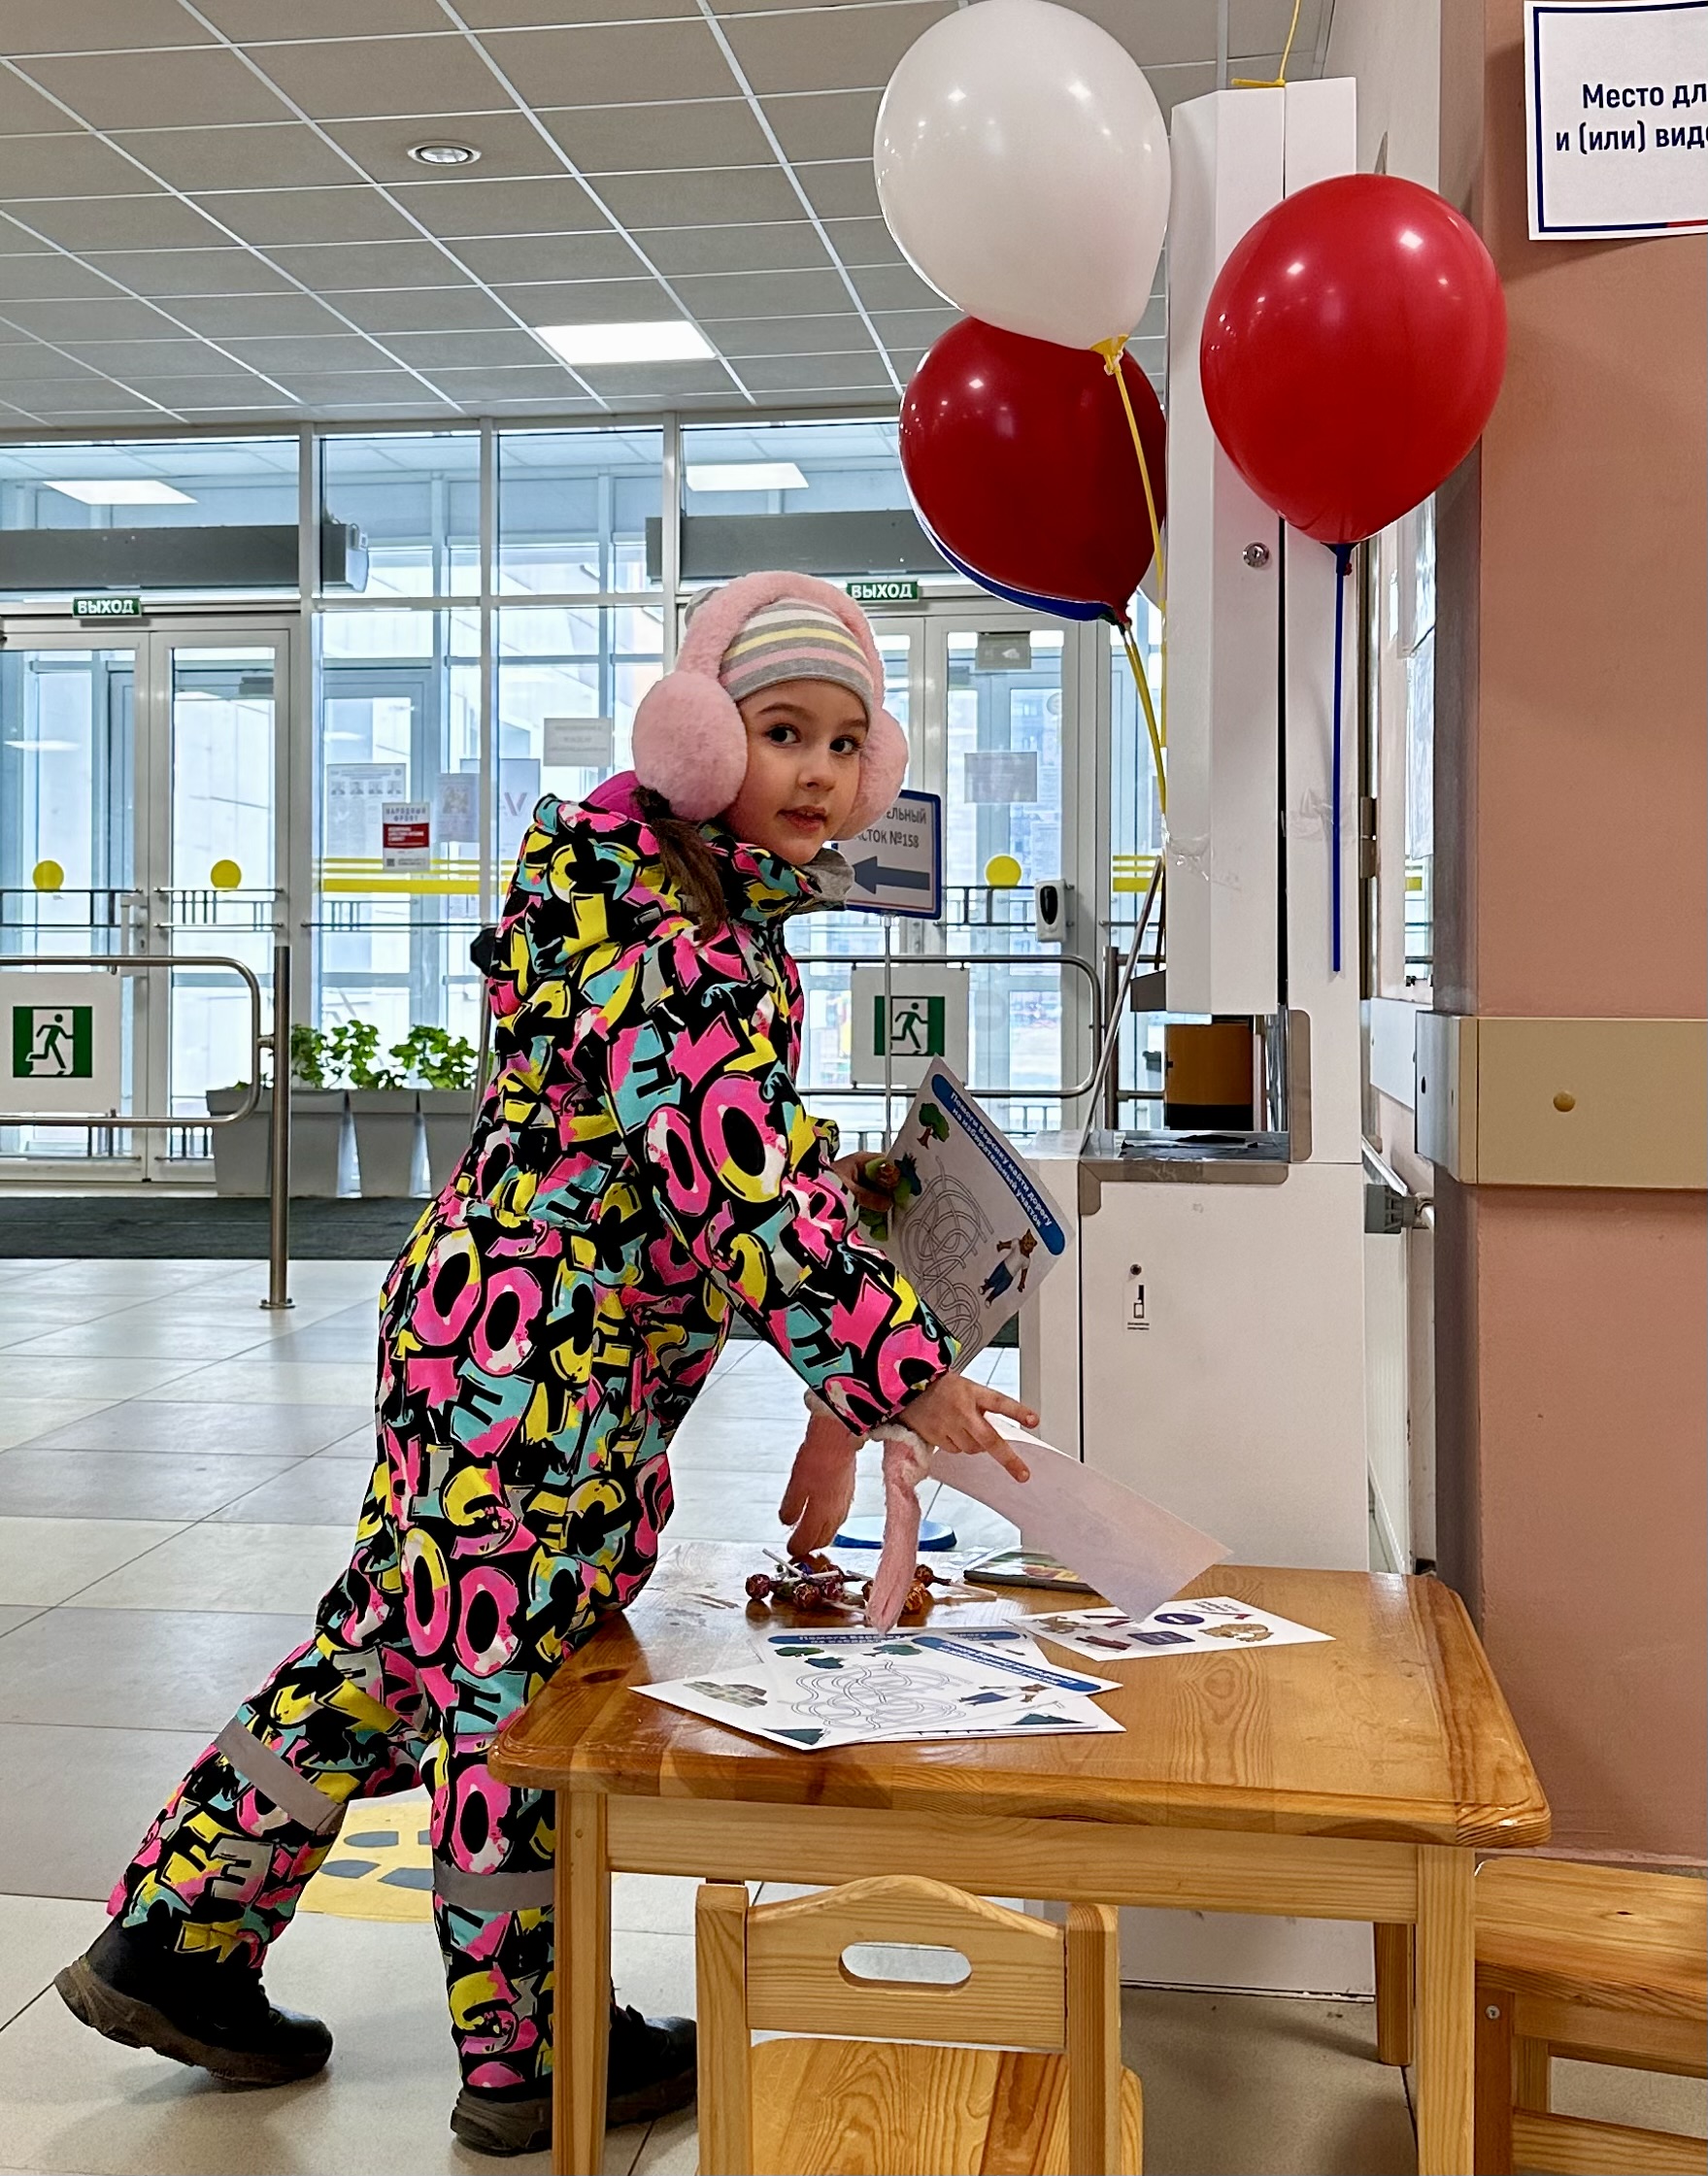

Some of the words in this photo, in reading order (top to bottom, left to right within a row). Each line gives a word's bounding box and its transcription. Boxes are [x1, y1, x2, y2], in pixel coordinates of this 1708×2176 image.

[1583, 84, 1664, 109] Место
[1556, 132, 1569, 151] и
[1579, 119, 1646, 154] (или)
[1656, 125, 1708, 150] вид
[852, 584, 913, 599] ВЫХОД
[78, 599, 135, 615] ВЫХОД
[889, 830, 920, 849] №158
[951, 1091, 979, 1128] Помоги
[978, 1125, 1010, 1164] Барсику
[1009, 1163, 1029, 1192] найти
[1027, 1191, 1053, 1226] дорогу
[1016, 1188, 1042, 1227] участок
